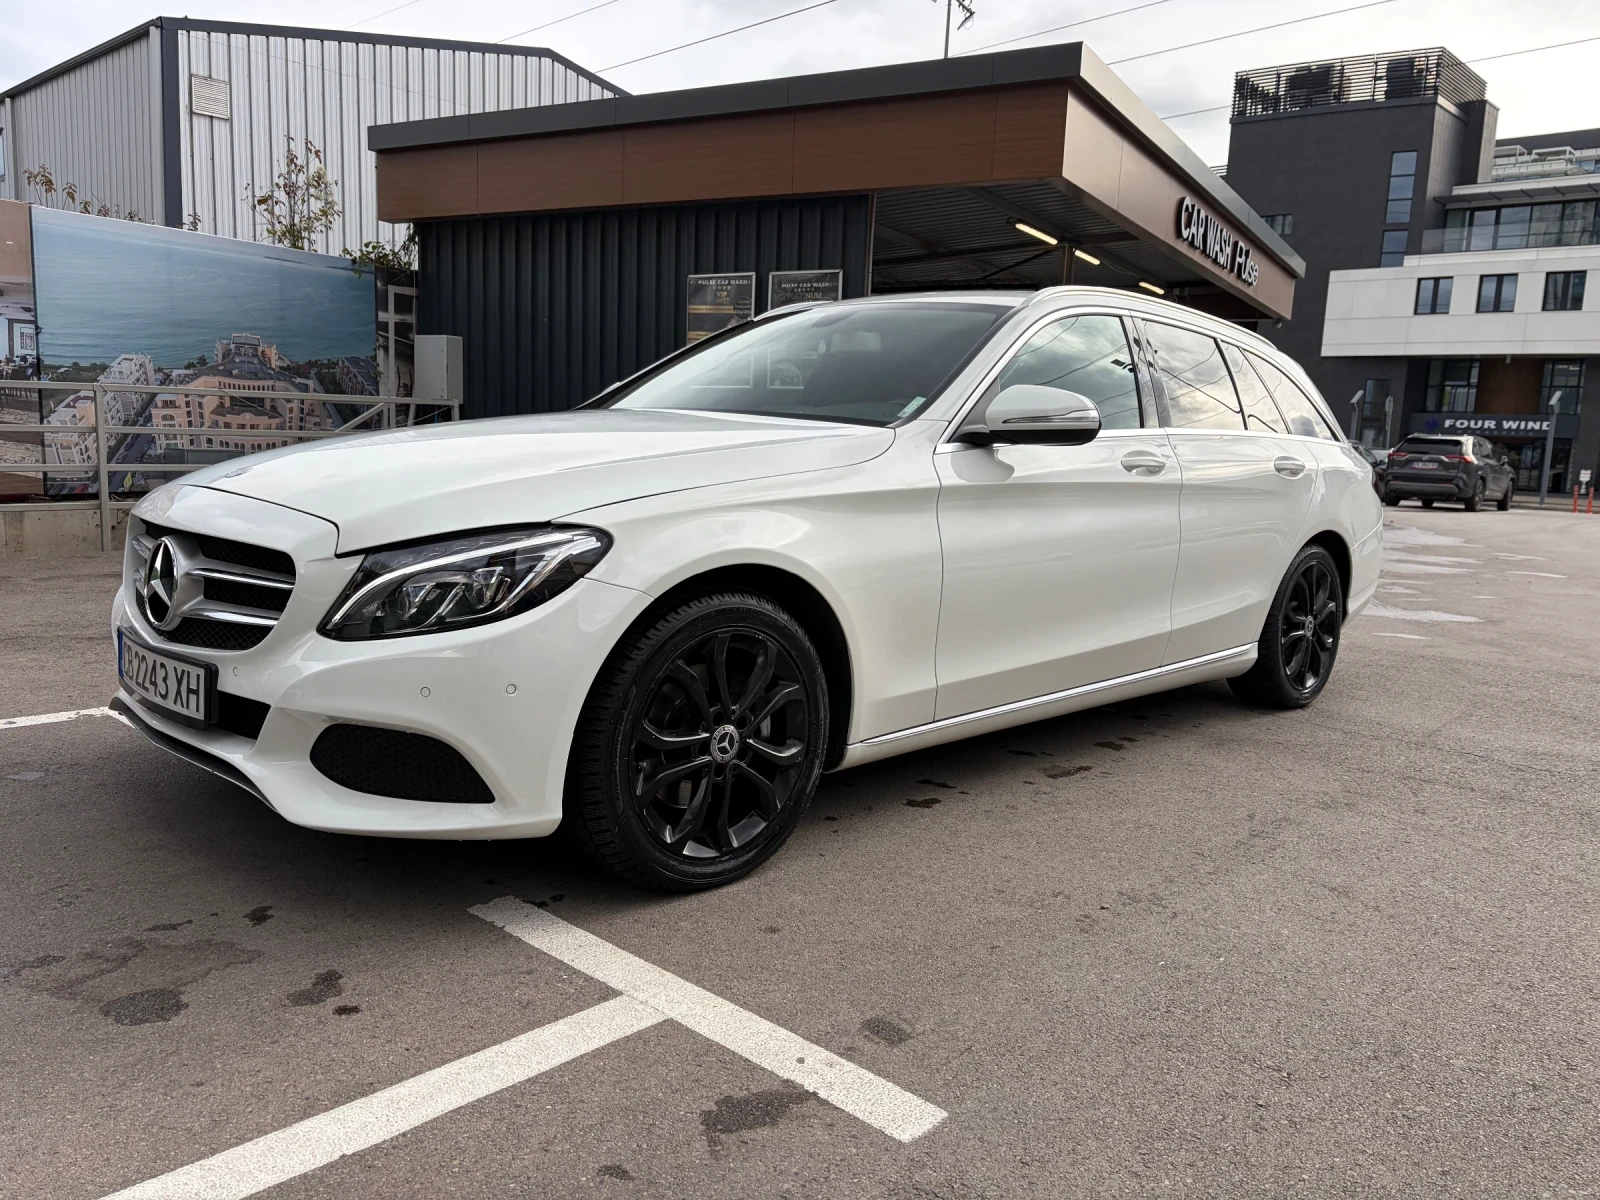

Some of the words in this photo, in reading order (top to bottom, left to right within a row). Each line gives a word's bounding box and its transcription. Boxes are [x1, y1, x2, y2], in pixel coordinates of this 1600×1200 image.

[1180, 196, 1206, 250] CAR
[1206, 214, 1233, 270] WASH
[1234, 239, 1259, 286] Pulse
[1444, 419, 1496, 430] FOUR
[134, 650, 169, 701] 2243
[173, 666, 201, 713] XH
